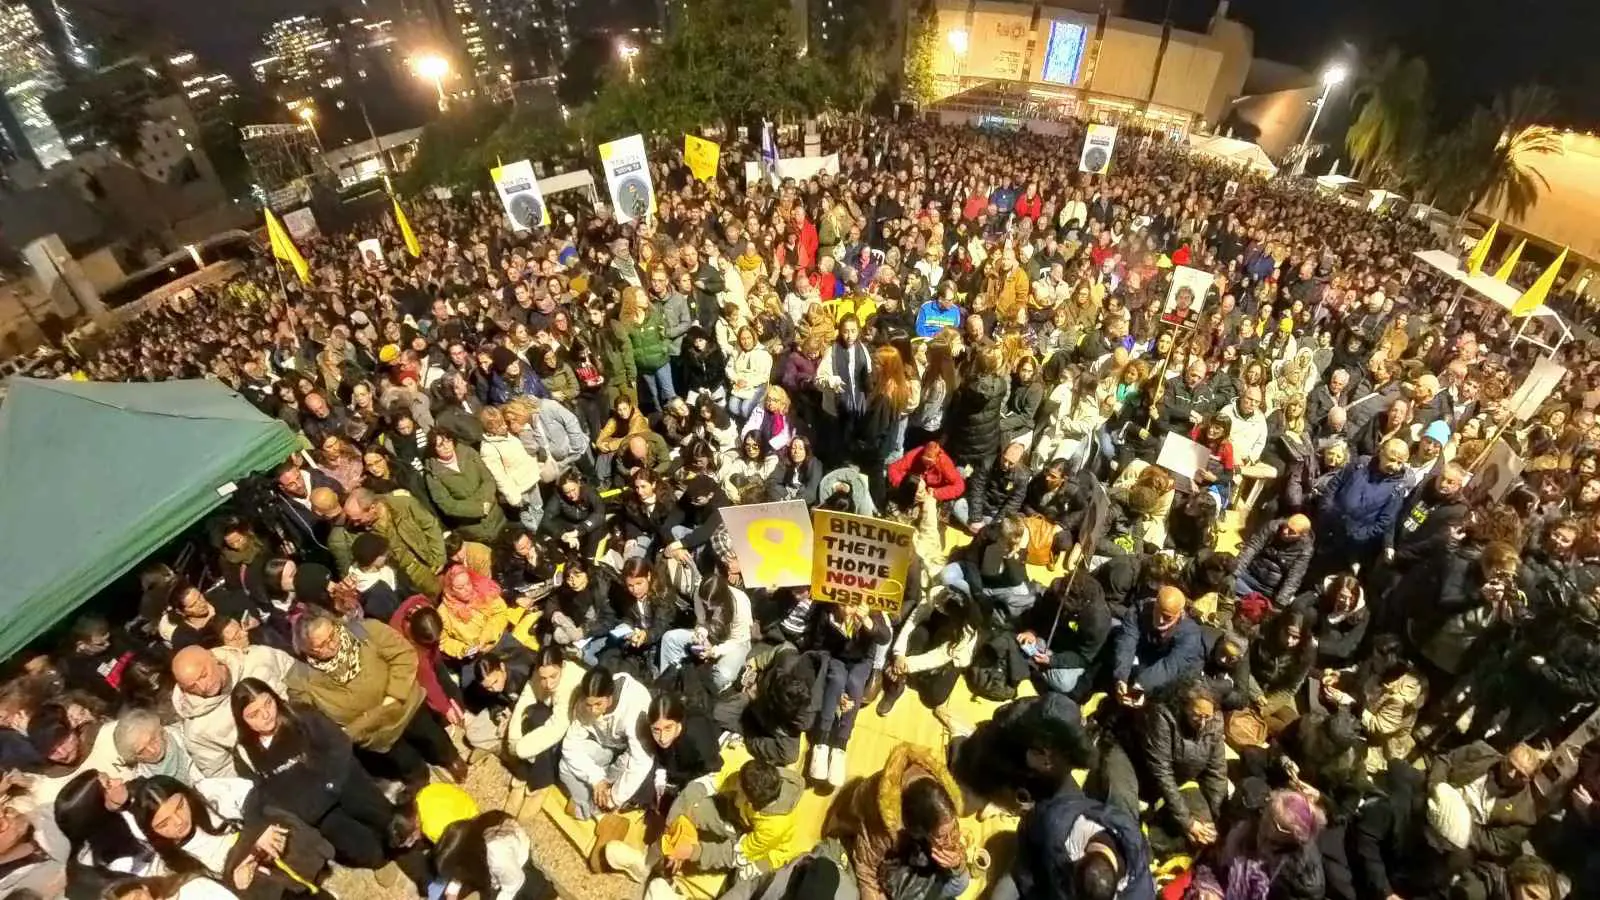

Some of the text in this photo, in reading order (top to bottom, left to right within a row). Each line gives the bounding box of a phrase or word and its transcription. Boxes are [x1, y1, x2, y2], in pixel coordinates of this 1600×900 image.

[831, 518, 910, 547] BRING
[822, 535, 887, 560] THEM
[826, 555, 889, 578] HOME
[825, 571, 877, 590] NOW
[822, 586, 899, 611] 493 DAYS
